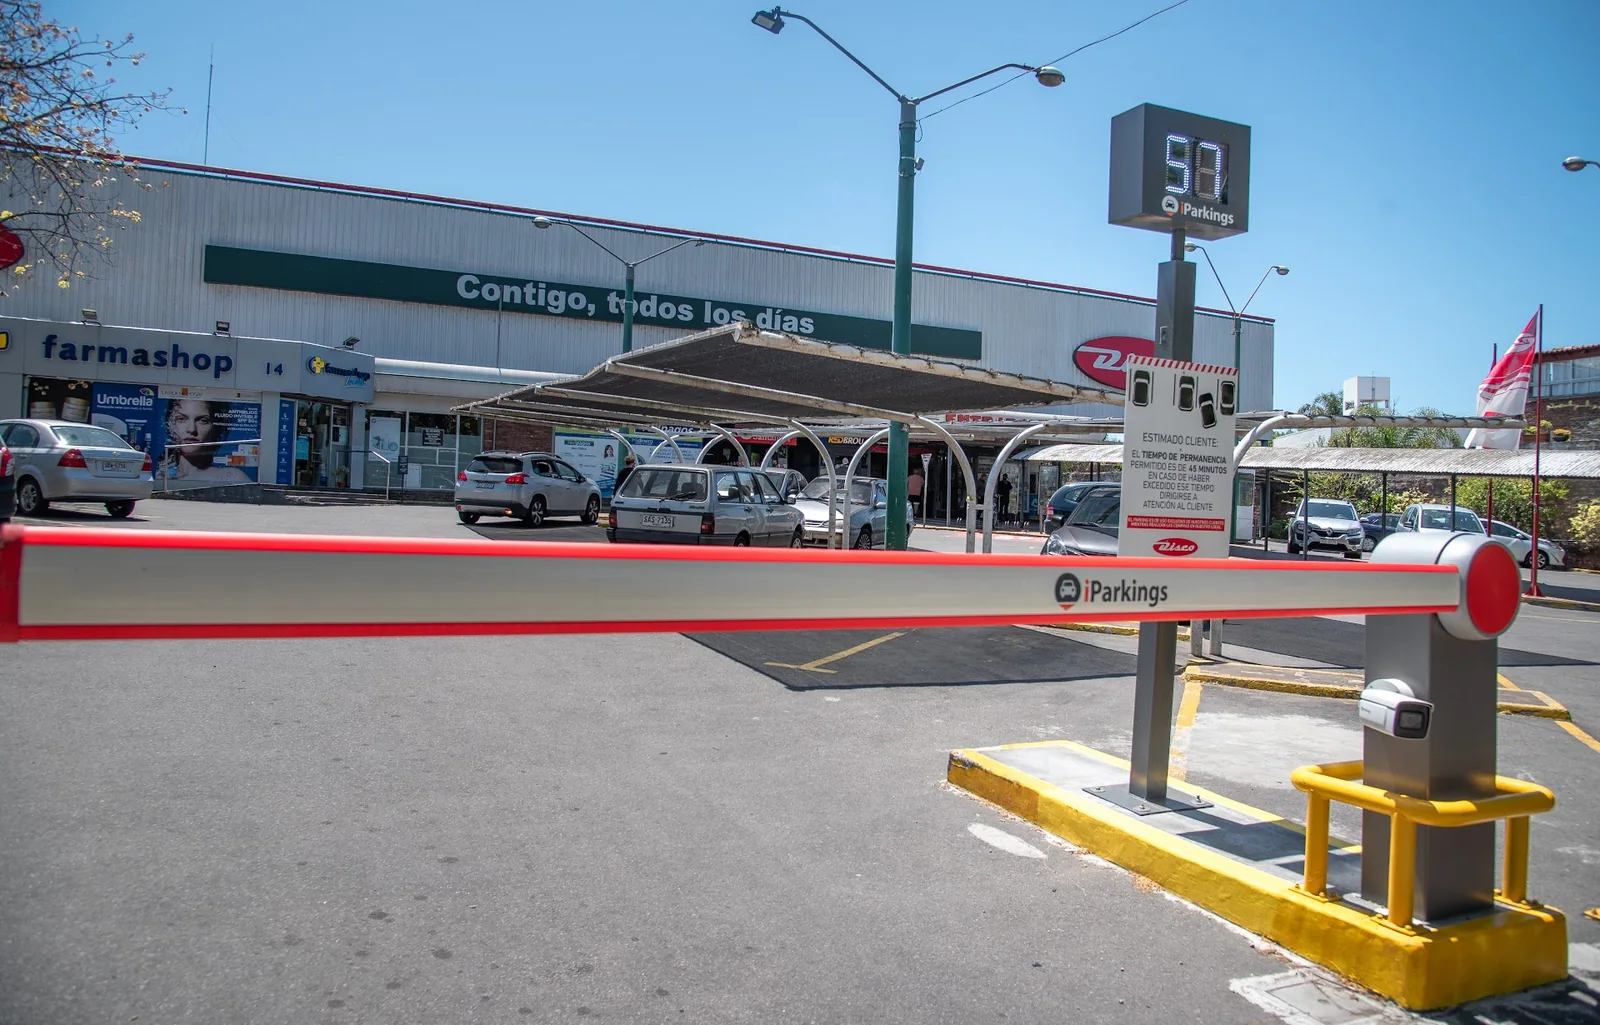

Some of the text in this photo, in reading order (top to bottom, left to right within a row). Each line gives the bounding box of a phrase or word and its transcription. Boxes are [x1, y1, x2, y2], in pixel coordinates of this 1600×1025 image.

[1165, 134, 1222, 198] 57
[1180, 201, 1234, 226] iParkings
[456, 274, 596, 317] Contigo,
[703, 301, 747, 324] los
[755, 307, 815, 334] días
[42, 334, 234, 379] farmashop
[266, 362, 284, 376] 14
[97, 393, 153, 407] Umbrella
[1142, 432, 1219, 448] ESTIMADO CLIENTE:
[1132, 450, 1227, 464] EL TIEMPO DE PERMANENCIA
[1130, 460, 1227, 474] PERMITIDO ES DE 45 MINUTOS
[1148, 471, 1210, 482] EN CASO DE HABER
[1143, 480, 1214, 492] EXCEDIDO ESE TIEMPO
[1160, 491, 1192, 500] DIRIGIRSE
[1142, 499, 1213, 511] ATENCIÓN AL CLIENTE
[1157, 541, 1196, 551] Disco
[1084, 578, 1168, 607] iParkings
